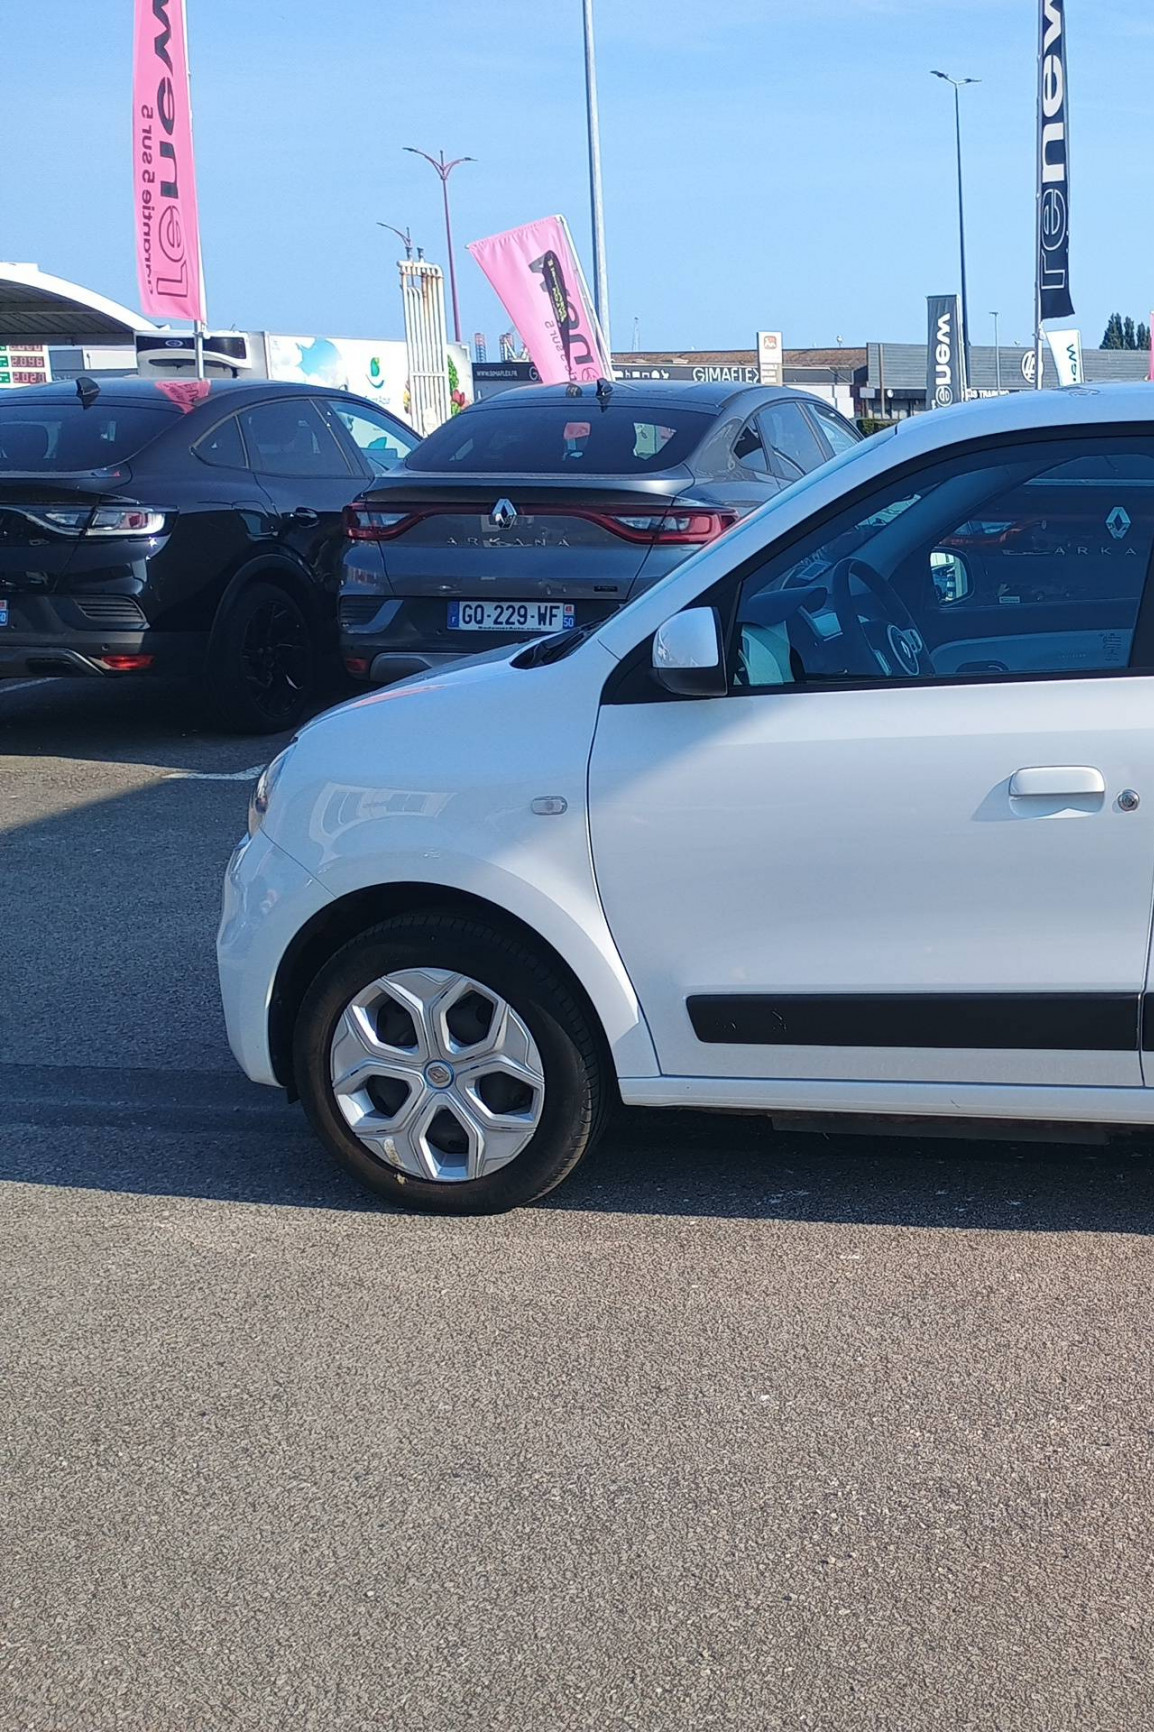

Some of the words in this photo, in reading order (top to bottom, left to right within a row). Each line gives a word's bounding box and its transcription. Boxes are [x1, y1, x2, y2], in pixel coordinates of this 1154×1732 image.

[447, 537, 570, 549] ARKANA
[462, 604, 561, 626] GQ-229-WF
[563, 617, 574, 627] 50
